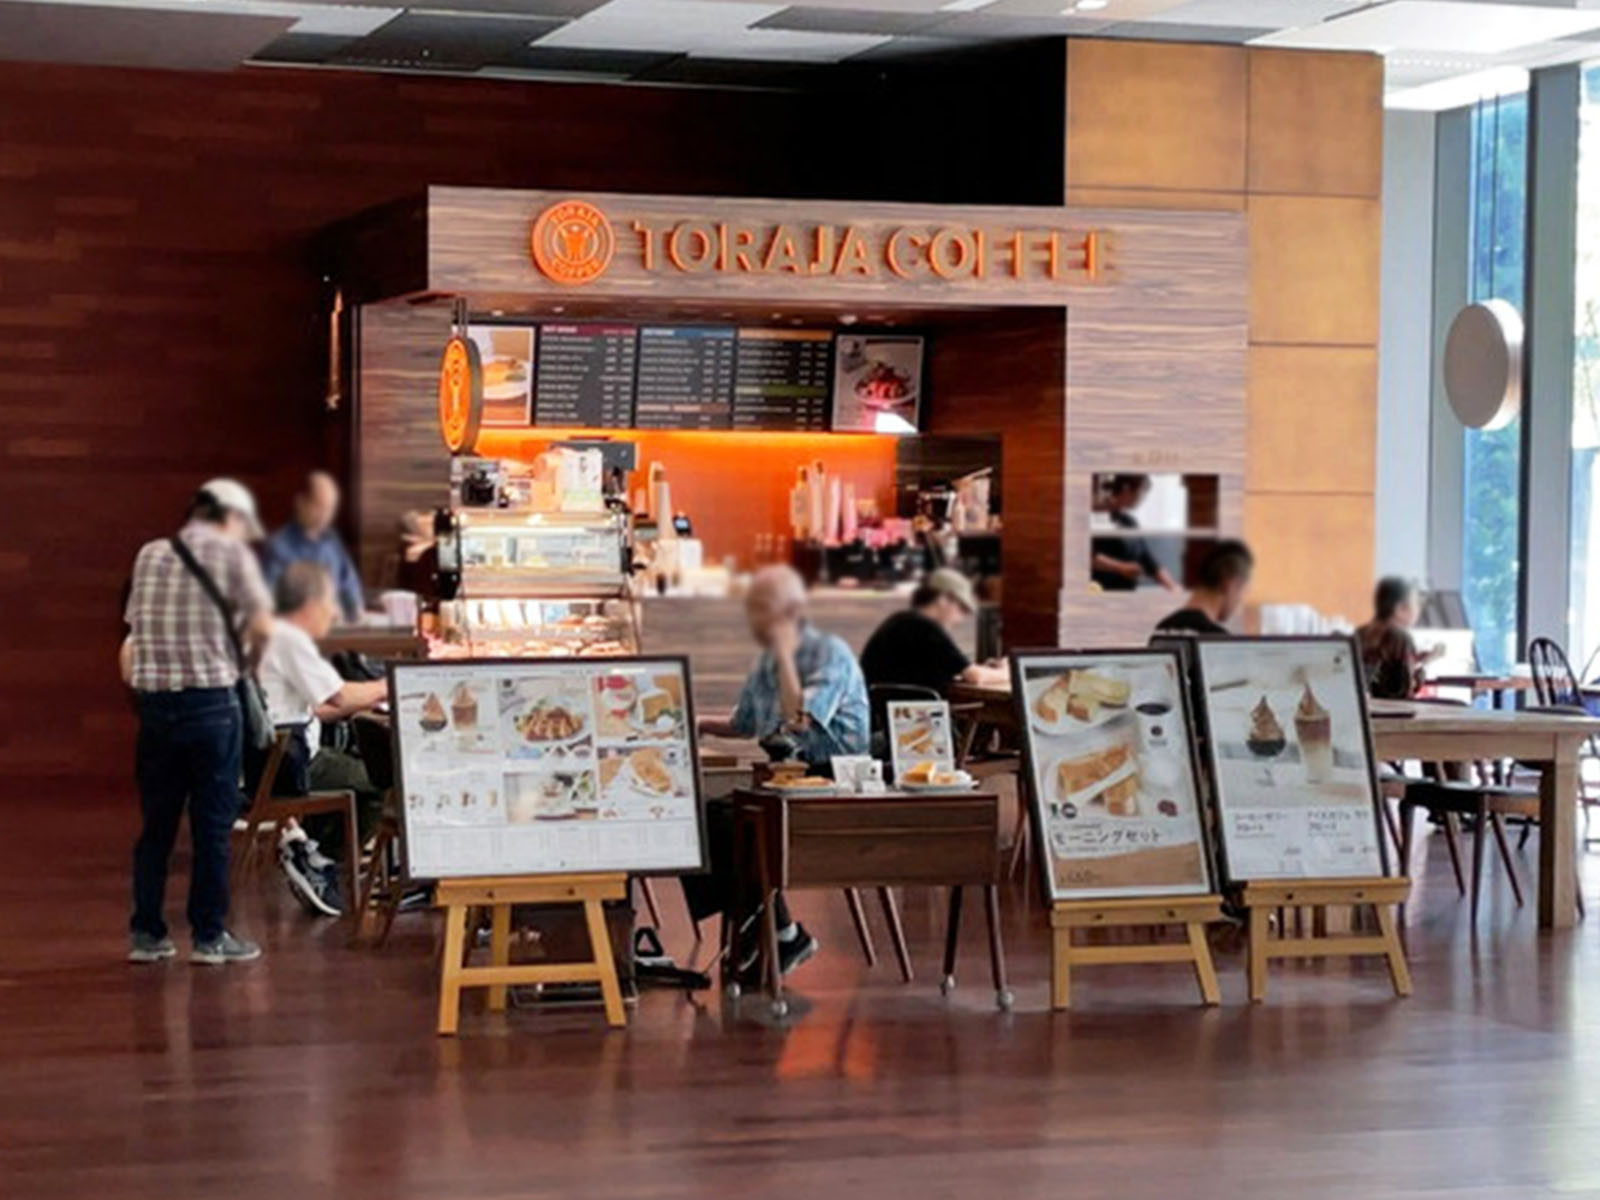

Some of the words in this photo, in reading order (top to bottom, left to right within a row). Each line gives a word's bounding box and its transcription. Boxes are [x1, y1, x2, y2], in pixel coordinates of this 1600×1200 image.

[631, 219, 869, 275] TORAJA
[884, 226, 1117, 281] COFFEE
[1053, 827, 1161, 846] モーニングセット
